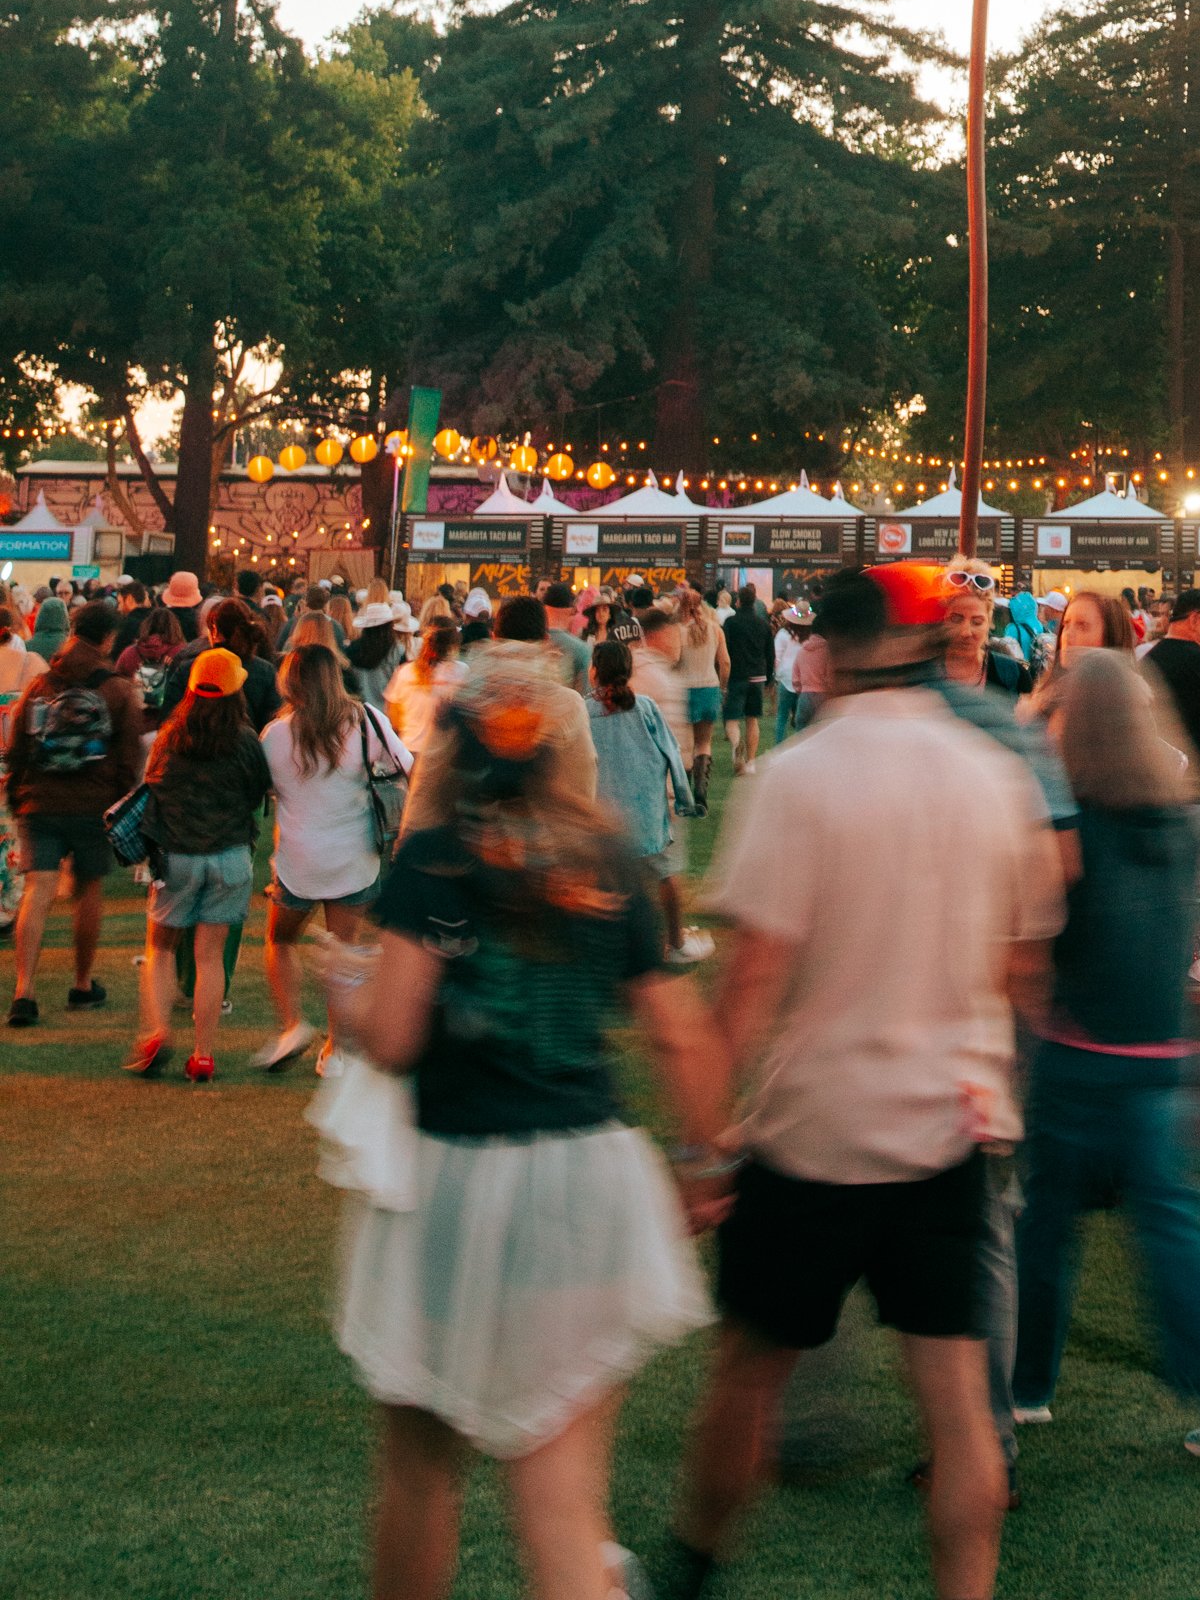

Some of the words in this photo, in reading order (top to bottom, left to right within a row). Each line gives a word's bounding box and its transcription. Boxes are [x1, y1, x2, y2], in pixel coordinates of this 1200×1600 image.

[448, 530, 488, 541] MARGARITA
[489, 531, 507, 542] TACO
[507, 531, 522, 542] BAR
[771, 529, 792, 539] SLOW
[792, 529, 822, 539] SMOKED
[934, 528, 948, 538] NEW
[602, 533, 642, 544] MARGARITA
[643, 533, 662, 545] TACO
[662, 534, 677, 545] BAR
[918, 538, 947, 547] LOBSTER
[1077, 536, 1100, 545] REFINED
[1102, 536, 1126, 545] FLAVORS
[1127, 536, 1135, 545] OF
[1136, 536, 1149, 545] ASIA
[0, 540, 68, 550] FORMATION
[770, 540, 806, 550] AMERICAN
[807, 540, 822, 551] BBQ
